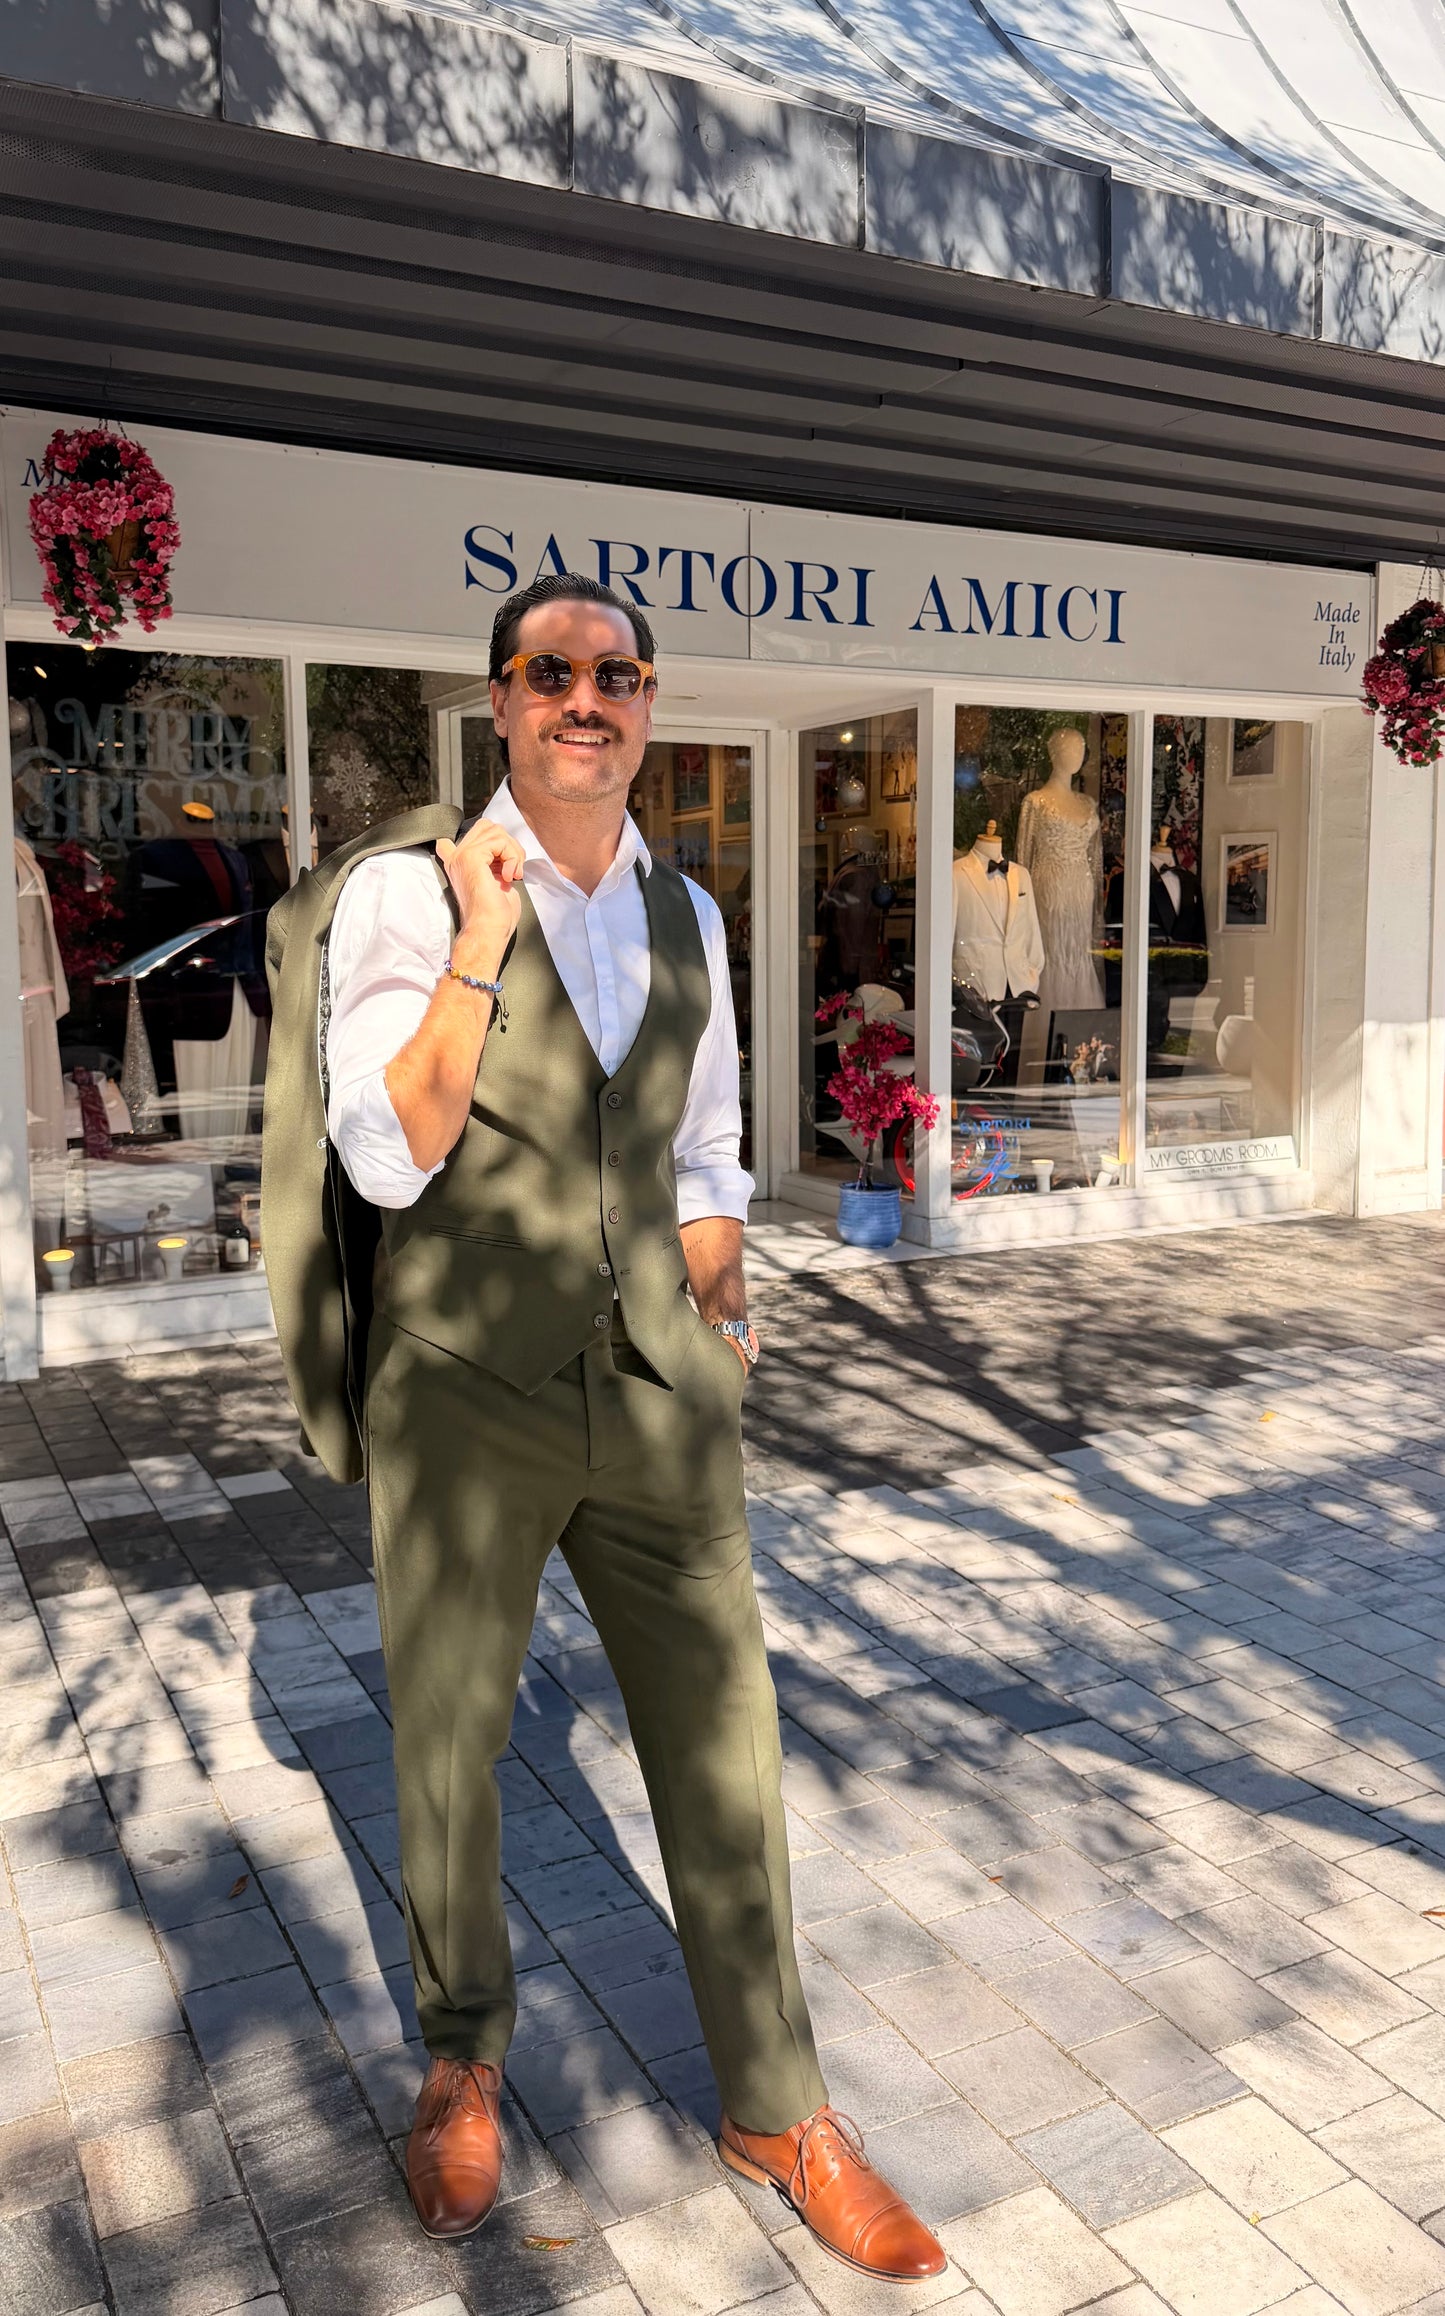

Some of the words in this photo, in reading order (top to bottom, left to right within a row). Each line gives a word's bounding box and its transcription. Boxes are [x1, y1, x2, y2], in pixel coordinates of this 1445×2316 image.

[464, 525, 876, 627] SARTORI
[908, 574, 1128, 643] AMICI
[1313, 601, 1361, 623] Made
[1328, 624, 1345, 644] In
[1319, 645, 1356, 673] Italy
[54, 690, 274, 783] MERRY
[1150, 1152, 1171, 1168] MY
[1176, 1147, 1234, 1166] GROOMS
[1239, 1143, 1279, 1160] ROOM
